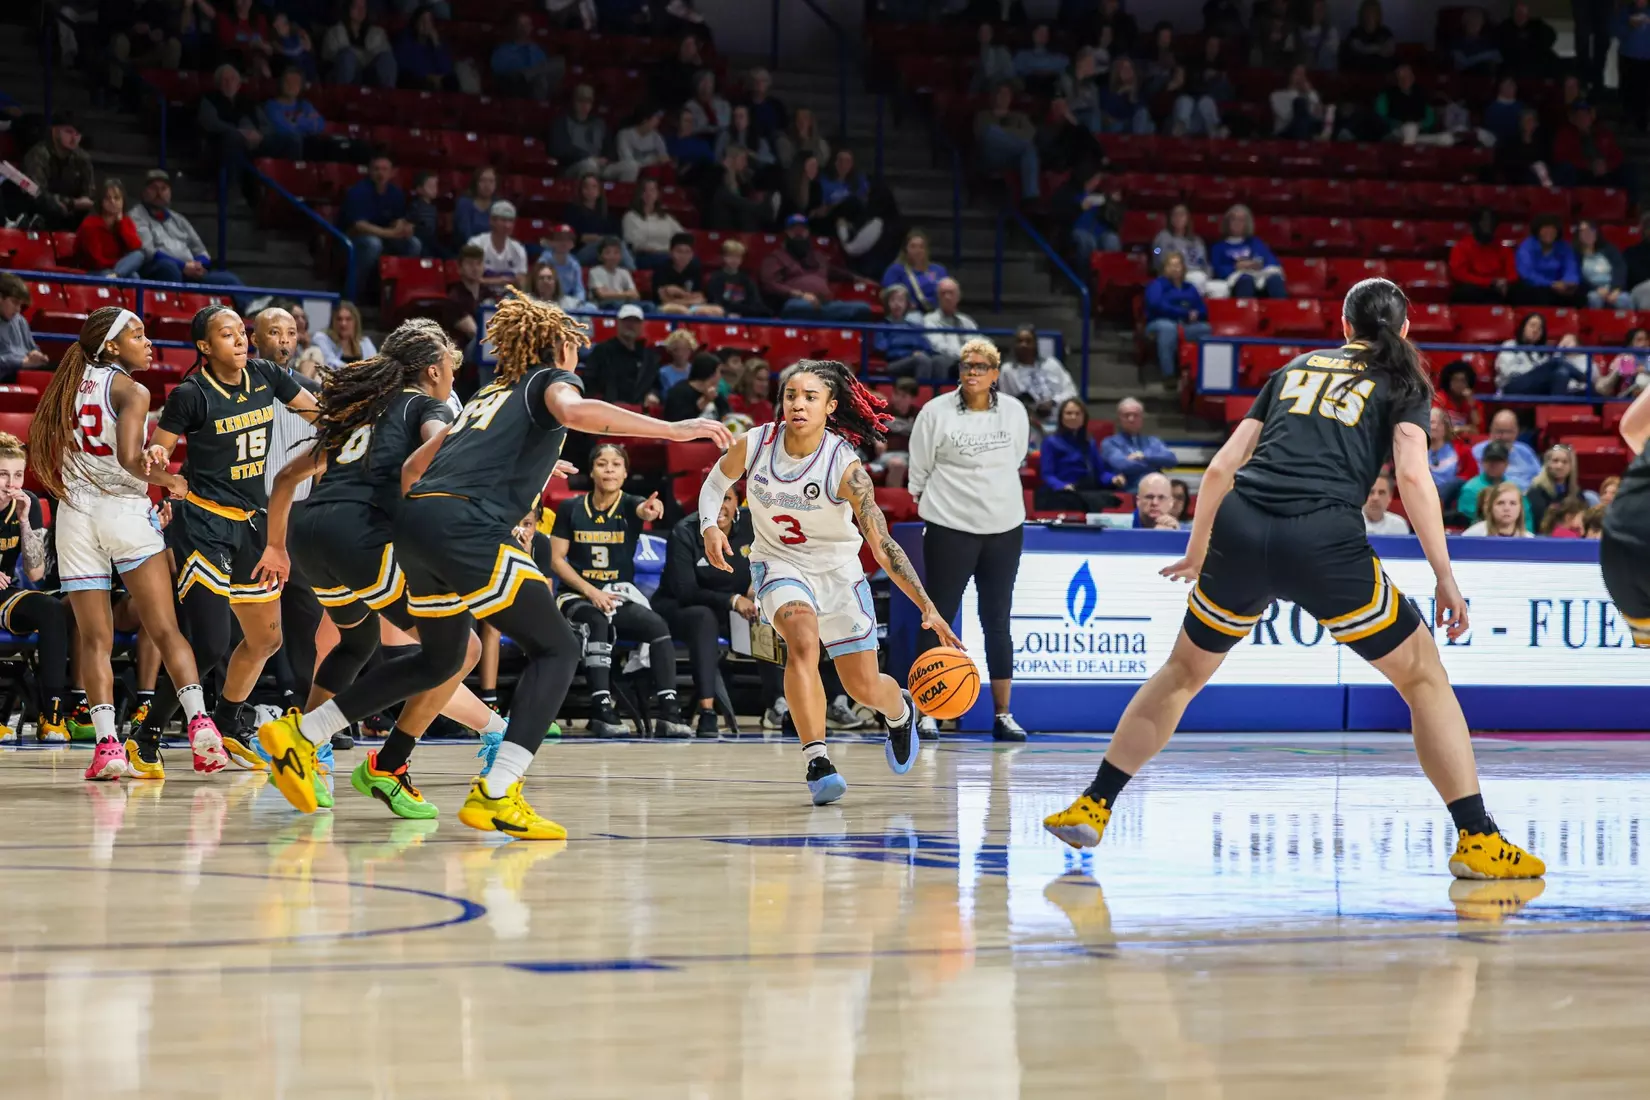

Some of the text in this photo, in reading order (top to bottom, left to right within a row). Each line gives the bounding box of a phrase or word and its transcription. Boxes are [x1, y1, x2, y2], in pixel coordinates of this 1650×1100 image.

[73, 404, 113, 456] 2
[236, 427, 267, 461] 15
[230, 460, 266, 480] STAT
[574, 530, 625, 543] KENNESAW
[771, 514, 807, 544] 3
[591, 546, 609, 568] 3
[1528, 599, 1636, 649] FUE
[1012, 659, 1147, 673] ROPANE DEALERS
[918, 680, 948, 705] NCAA
